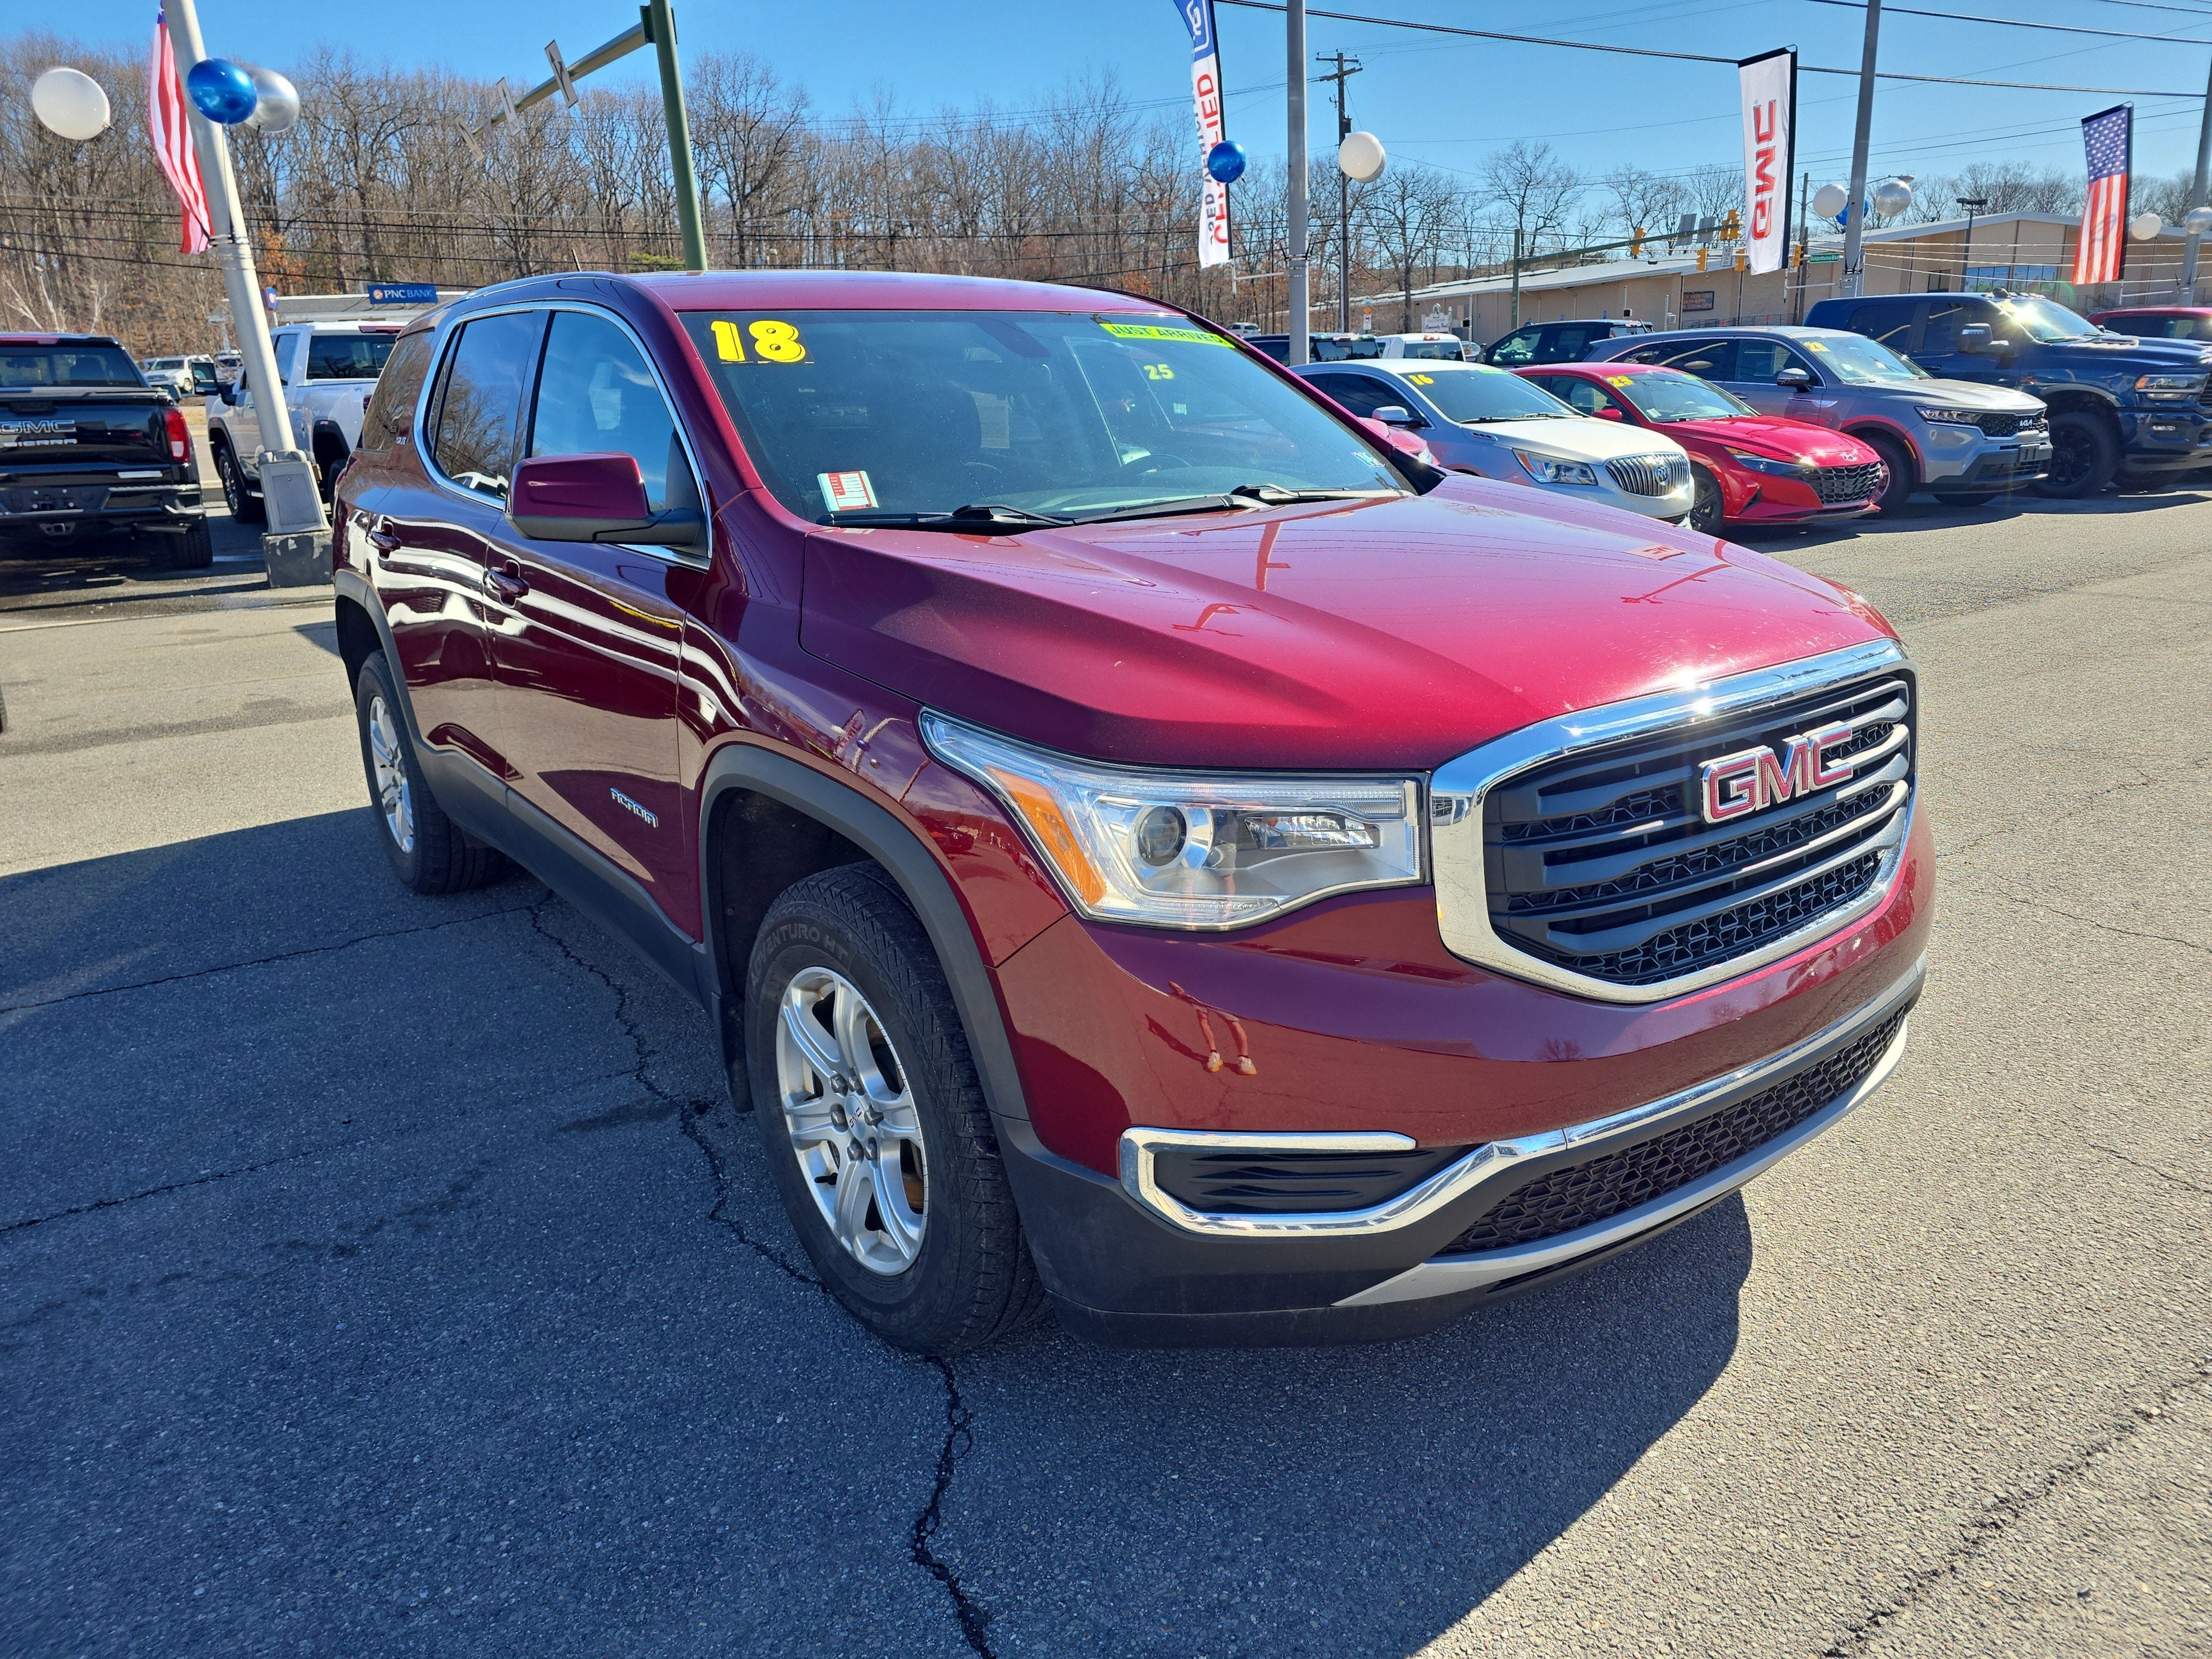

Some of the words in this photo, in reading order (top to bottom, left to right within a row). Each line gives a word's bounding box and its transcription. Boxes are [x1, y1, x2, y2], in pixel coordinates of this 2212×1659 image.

[1752, 99, 1776, 240] GMC
[384, 290, 406, 298] PNC
[407, 289, 433, 298] BANK
[711, 320, 806, 363] 18
[1111, 325, 1151, 335] JUST
[1155, 328, 1224, 343] ARRIVED
[1143, 364, 1174, 380] 25
[1409, 374, 1434, 385] 16
[1607, 376, 1634, 387] 23
[0, 419, 77, 434] GMC
[3, 438, 78, 448] SIERRA
[1701, 721, 1854, 824] GMC
[610, 787, 659, 828] ACADIA
[849, 1107, 861, 1128] GMC
